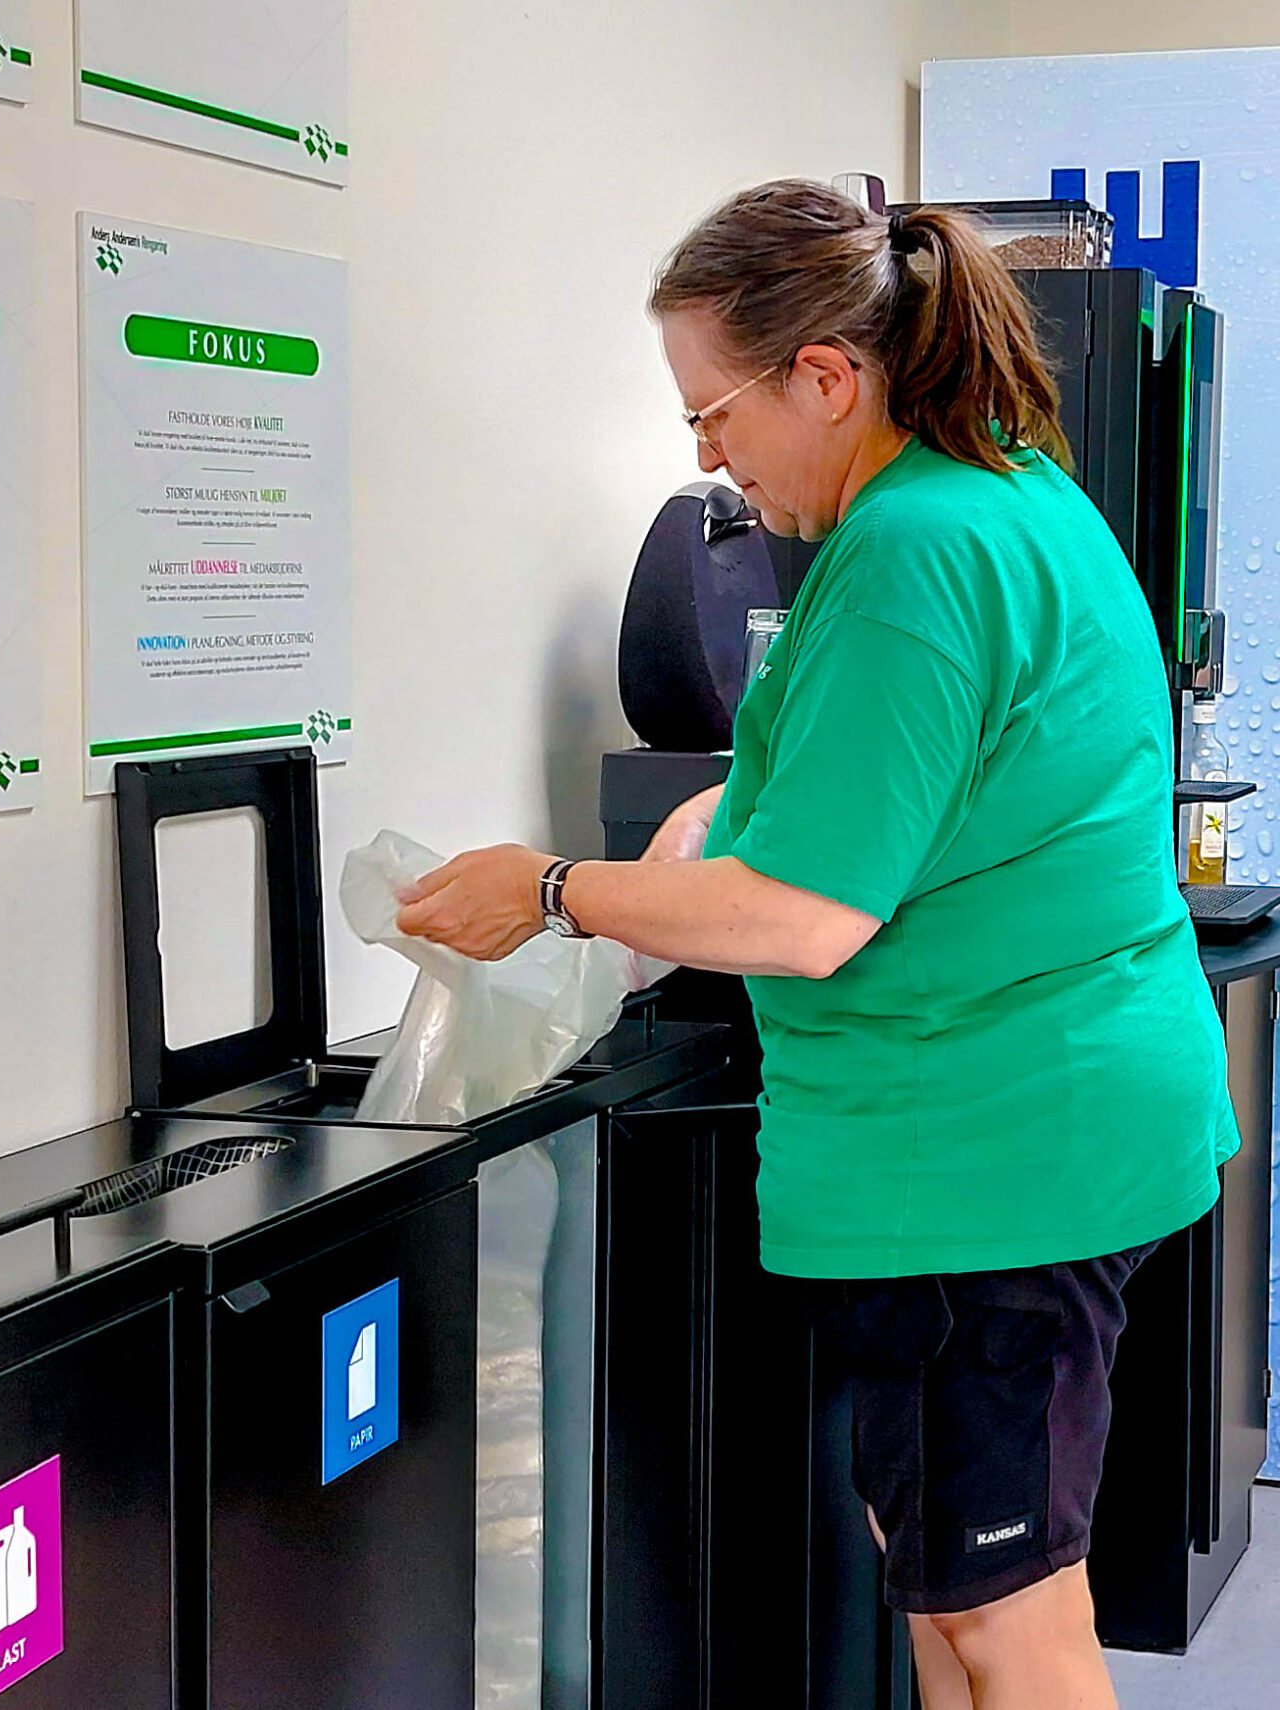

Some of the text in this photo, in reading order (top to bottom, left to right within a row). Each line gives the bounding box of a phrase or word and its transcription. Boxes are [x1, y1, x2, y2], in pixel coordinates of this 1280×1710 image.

[189, 329, 266, 365] FOKUS
[350, 1425, 373, 1451] PAPIR
[976, 1522, 1026, 1546] KANSAS
